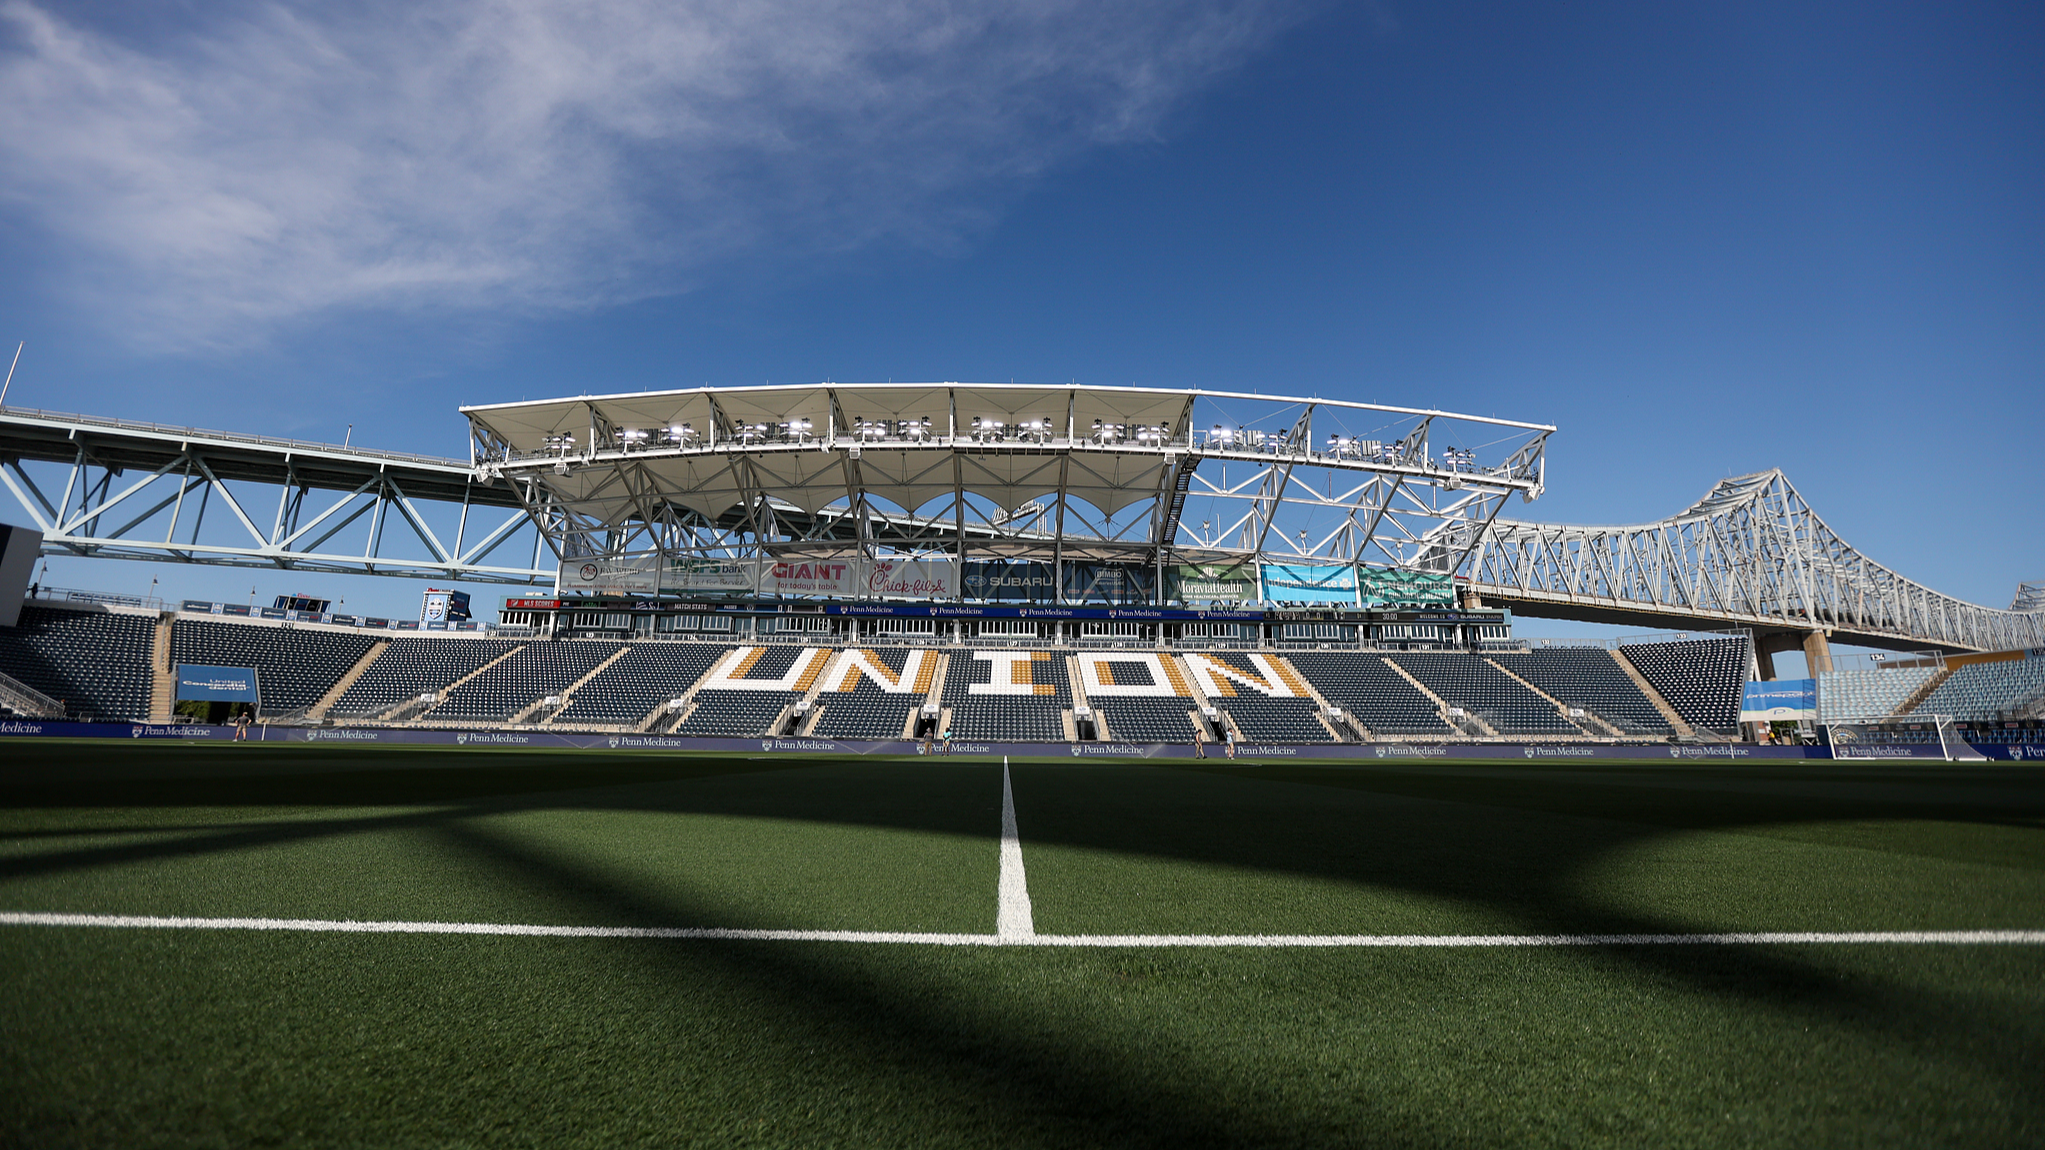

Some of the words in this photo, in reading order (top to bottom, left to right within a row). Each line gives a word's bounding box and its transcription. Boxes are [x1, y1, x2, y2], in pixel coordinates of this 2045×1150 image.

[670, 559, 721, 574] WSFS
[722, 564, 746, 574] bank
[771, 562, 847, 581] GIANT
[869, 563, 947, 596] Chick-fil-A
[989, 576, 1054, 587] SUBARU
[1264, 577, 1337, 589] Independence
[789, 582, 817, 591] today's
[818, 583, 838, 591] table
[1387, 580, 1449, 591] NEMOURS
[1425, 592, 1451, 601] HEALTH
[849, 605, 865, 613] Penn
[865, 606, 894, 614] Medicine
[955, 607, 983, 615] Medicine
[1028, 608, 1044, 616] Penn
[1044, 609, 1073, 617] Medicine
[1117, 609, 1133, 617] Penn
[1133, 610, 1162, 618] Medicine
[1206, 610, 1222, 618] Penn
[1222, 610, 1251, 619] Medicine
[1381, 612, 1399, 621] 30:00
[1870, 653, 1886, 661] 134
[700, 647, 1309, 698] UNION
[144, 726, 165, 736] Penn
[165, 726, 211, 737] Medicine
[319, 729, 341, 739] Penn
[340, 730, 378, 740] Medicine
[469, 733, 490, 743] Penn
[490, 733, 529, 744] Medicine
[621, 736, 642, 746] Penn
[642, 737, 681, 747] Medicine
[774, 740, 796, 750] Penn
[796, 740, 835, 751] Medicine
[951, 744, 990, 753] Medicine
[1084, 745, 1105, 754] Penn
[1105, 745, 1144, 754] Medicine
[1237, 746, 1258, 755] Penn
[1258, 746, 1297, 756] Medicine
[1388, 746, 1409, 755] Penn
[1408, 746, 1447, 756] Medicine
[1536, 747, 1557, 756] Penn
[1557, 747, 1594, 756] Medicine
[1682, 747, 1703, 756] Penn
[1850, 746, 1872, 755] Penn
[1872, 746, 1912, 756] Medicine
